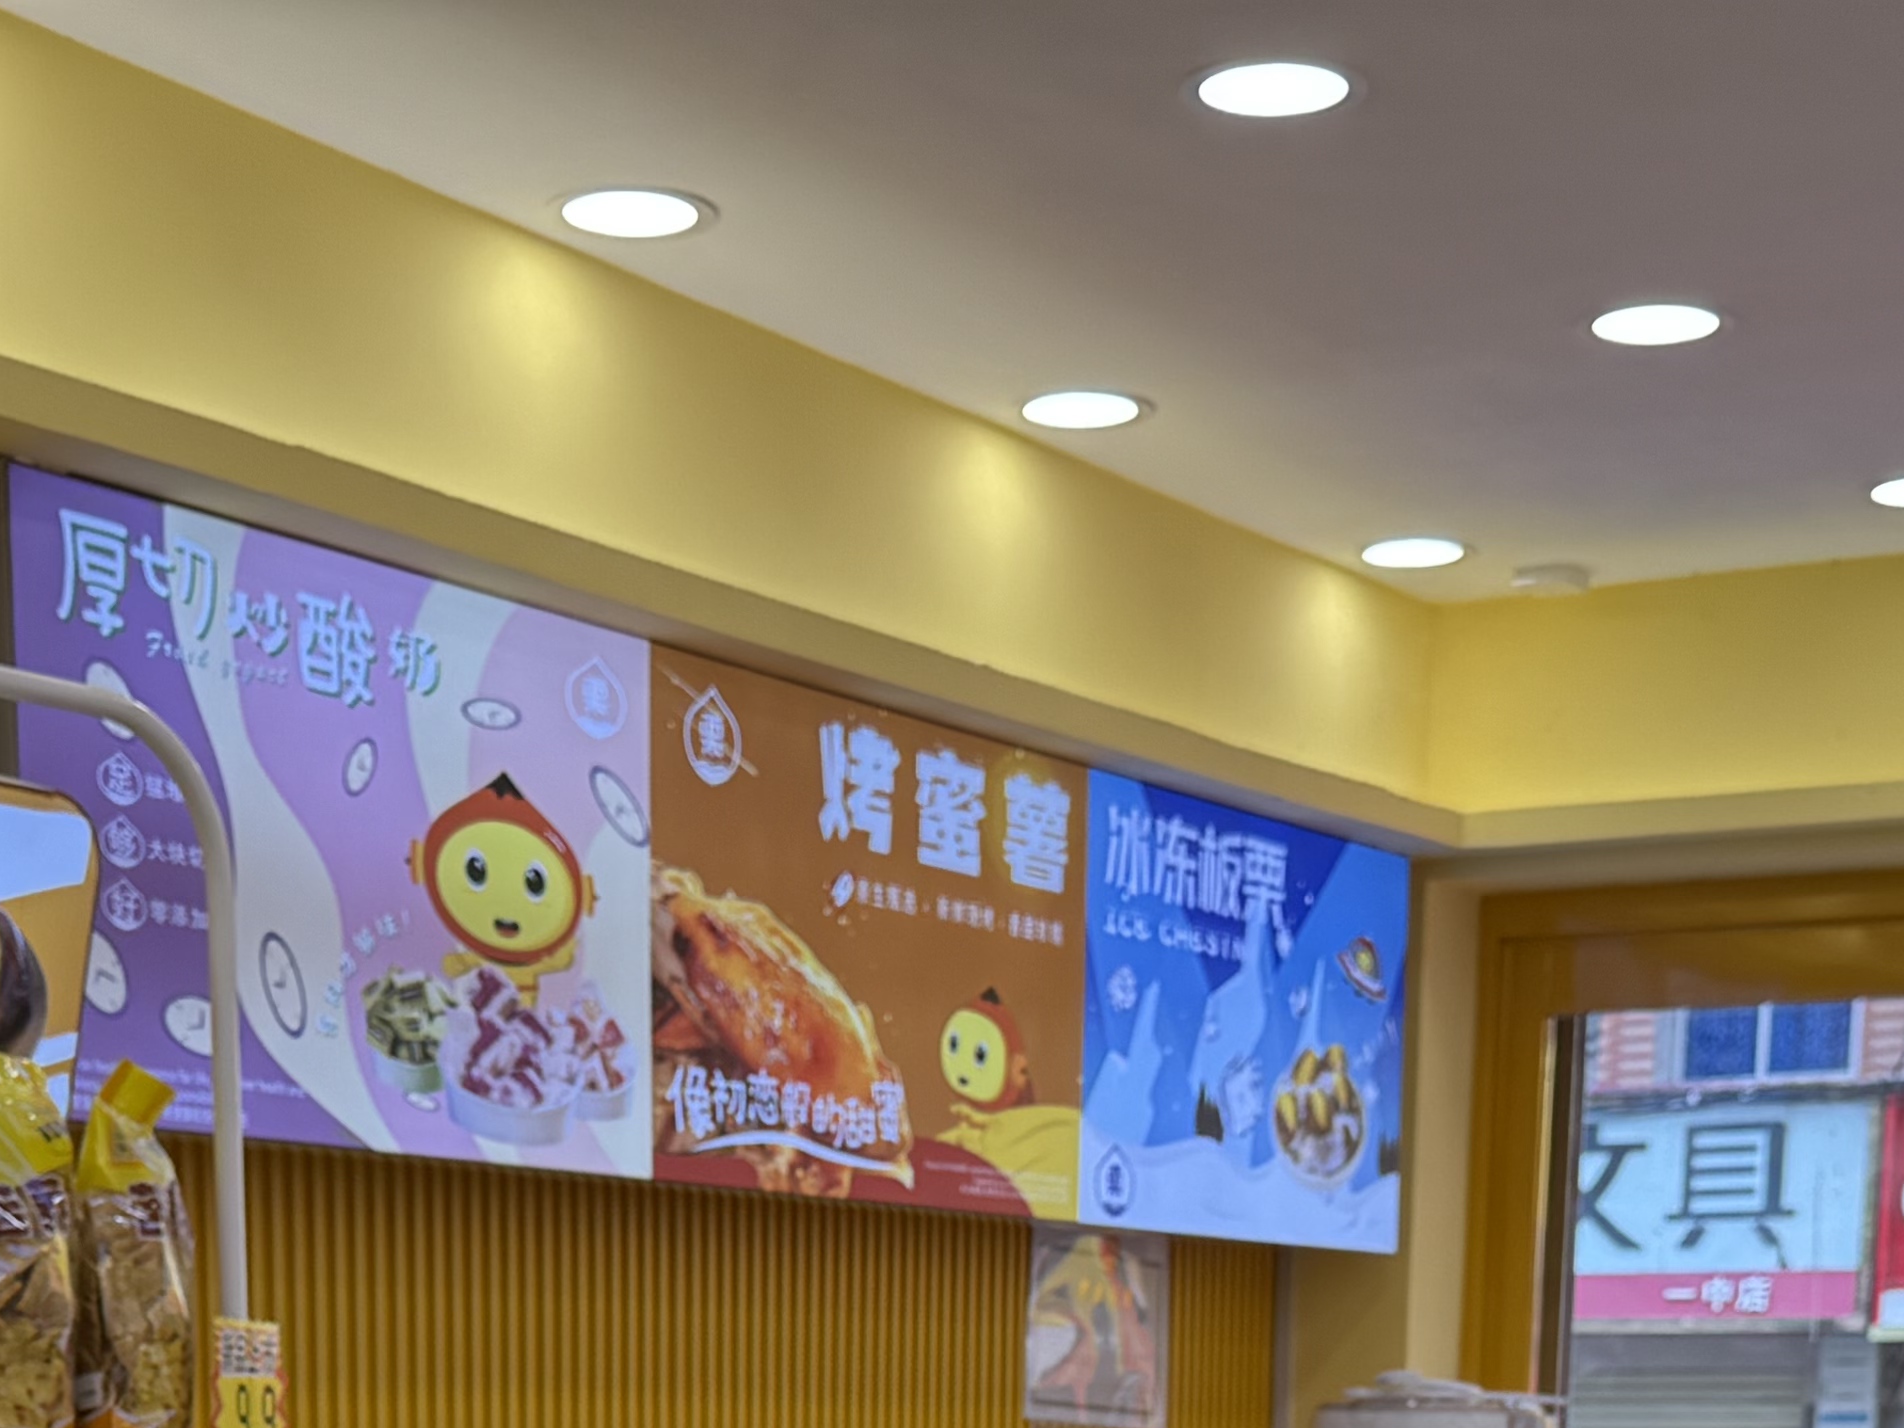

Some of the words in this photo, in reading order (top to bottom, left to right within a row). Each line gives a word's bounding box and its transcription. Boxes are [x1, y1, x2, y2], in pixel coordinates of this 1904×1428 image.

[57, 506, 441, 708] 厚切炒酸奶
[819, 720, 1072, 894] 烤蜜薯
[1104, 804, 1289, 930] 冰冻板栗
[666, 1063, 905, 1149] 像初恋般的甜蜜
